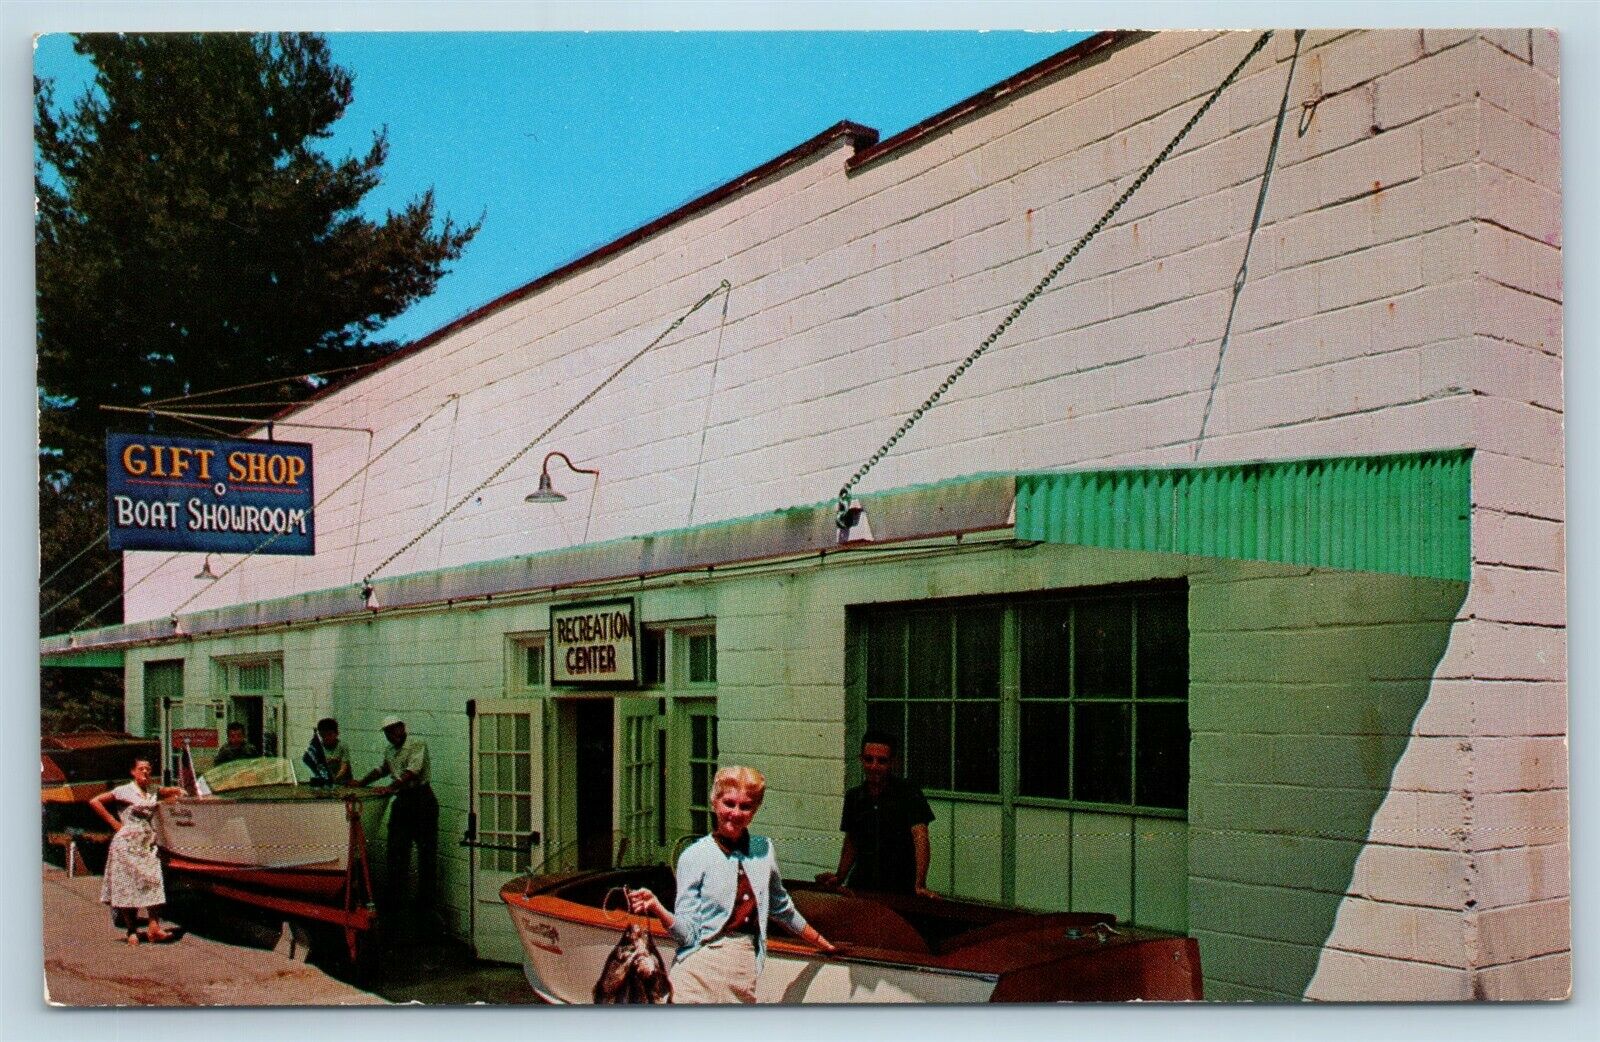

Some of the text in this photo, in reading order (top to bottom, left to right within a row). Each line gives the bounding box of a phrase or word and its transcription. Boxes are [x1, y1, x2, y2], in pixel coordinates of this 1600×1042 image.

[122, 444, 306, 486] GIFT SHOP
[114, 496, 307, 535] BOAT SHOWROOM
[556, 611, 635, 644] RECREATION
[566, 645, 617, 675] CENTER
